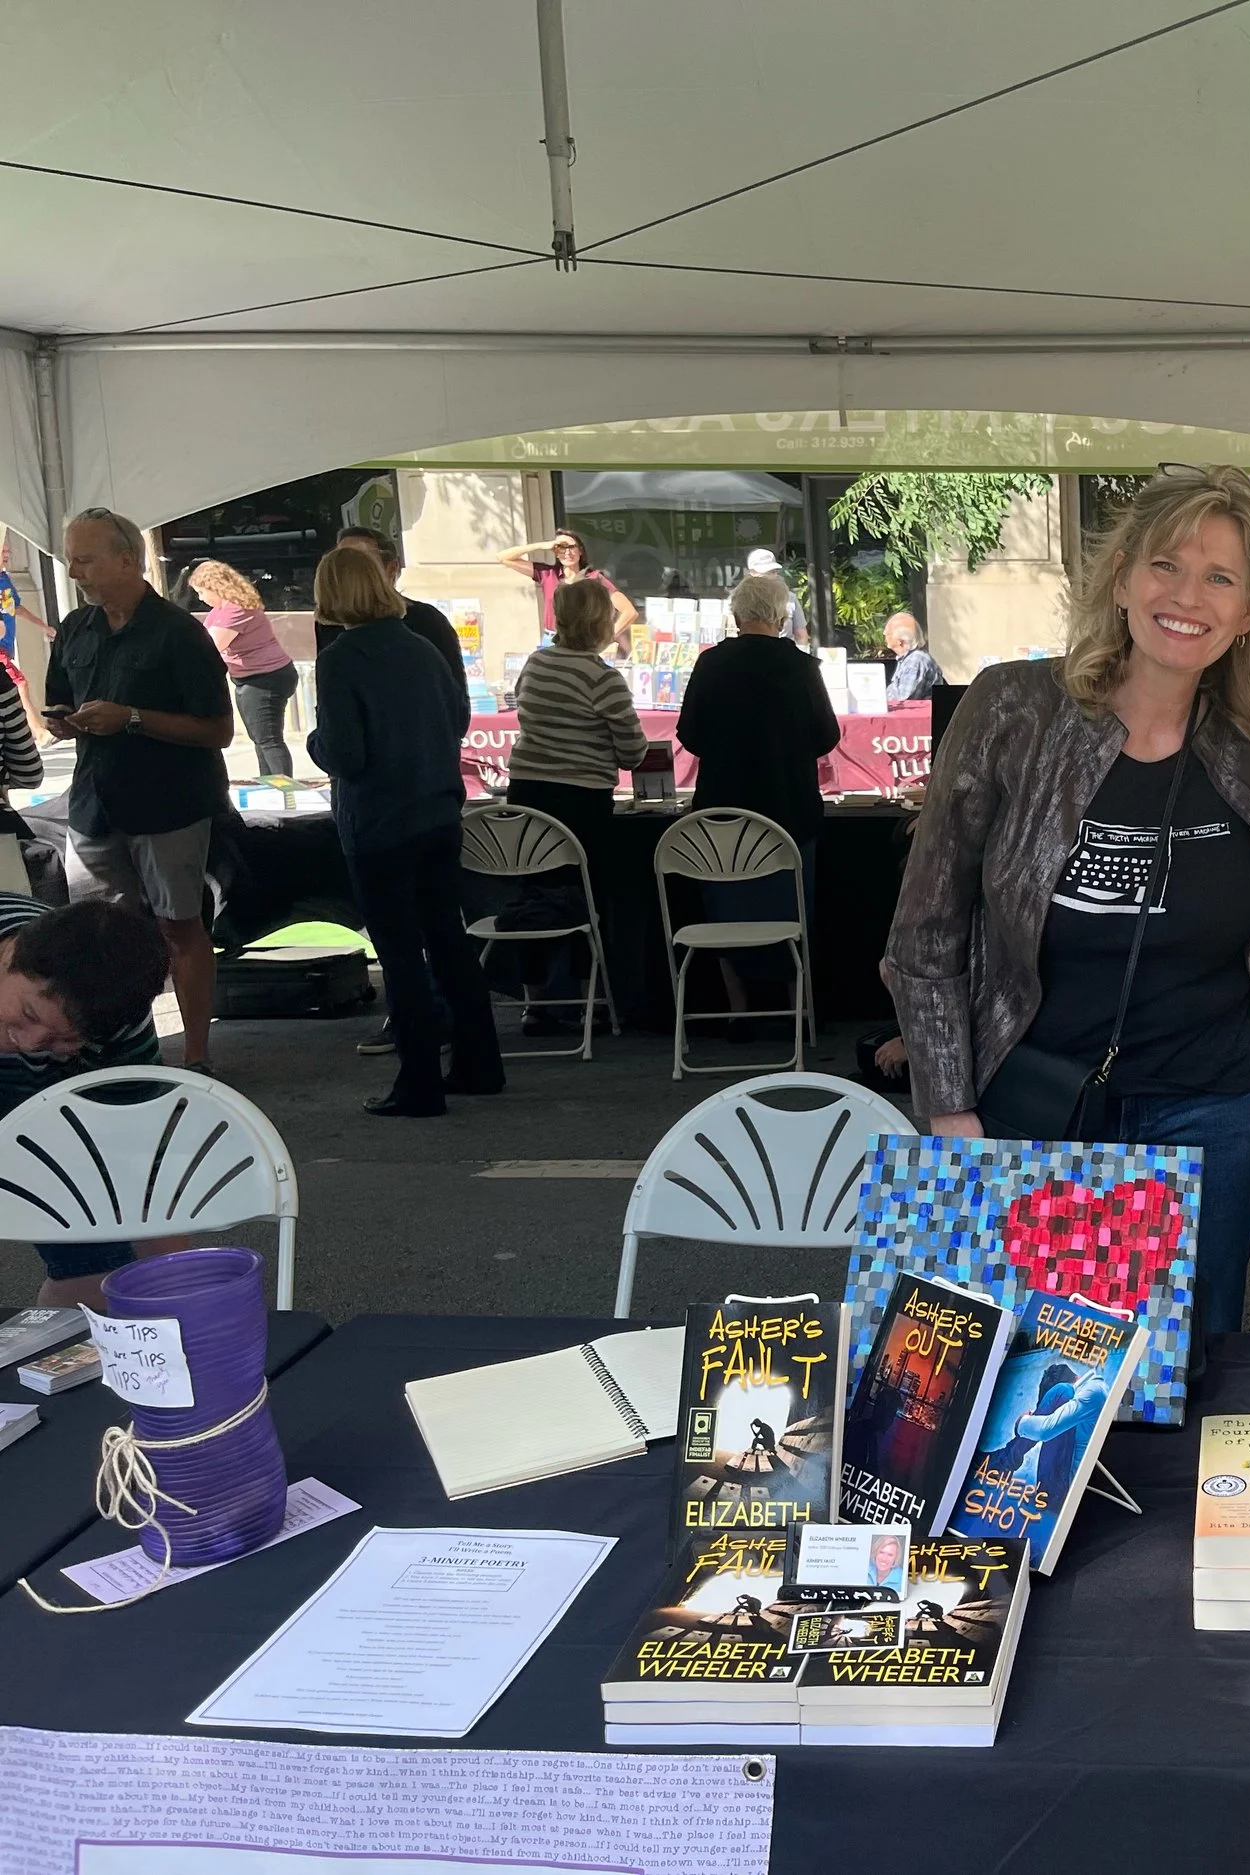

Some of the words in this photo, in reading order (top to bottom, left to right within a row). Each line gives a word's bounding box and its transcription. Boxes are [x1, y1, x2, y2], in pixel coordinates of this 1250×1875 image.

[1089, 831, 1104, 840] THE
[903, 1287, 984, 1341] ASHER'S
[125, 1324, 158, 1342] TIPS
[708, 1310, 824, 1342] ASHER'S
[1037, 1302, 1126, 1348] ELIZABETH
[904, 1326, 964, 1377] OUT
[1034, 1326, 1109, 1367] WHEELER
[131, 1350, 166, 1367] TIPS
[108, 1363, 141, 1391] TIPS
[1224, 1437, 1246, 1447] of
[840, 1462, 927, 1521] ELIZABETH
[973, 1454, 1049, 1510] ASHER'S
[685, 1500, 812, 1528] ELIZABETH
[963, 1488, 1044, 1540] SHOT
[418, 1556, 479, 1566] 3-MINUTE
[479, 1558, 529, 1568] POETRY
[808, 1617, 822, 1646] ELIZABETH
[637, 1641, 787, 1661] ELIZABETH
[829, 1647, 976, 1666] ELIZABETH
[638, 1660, 766, 1679] WHEELER
[831, 1664, 961, 1684] WHEELER
[450, 1757, 480, 1768] proud
[522, 1759, 540, 1767] one
[616, 1761, 643, 1773] thing
[682, 1764, 709, 1773] don't
[439, 1768, 467, 1778] think
[669, 1778, 688, 1786] one
[691, 1776, 726, 1787] knows
[473, 1782, 499, 1793] place
[619, 1788, 639, 1798] best
[705, 1792, 729, 1800] ever
